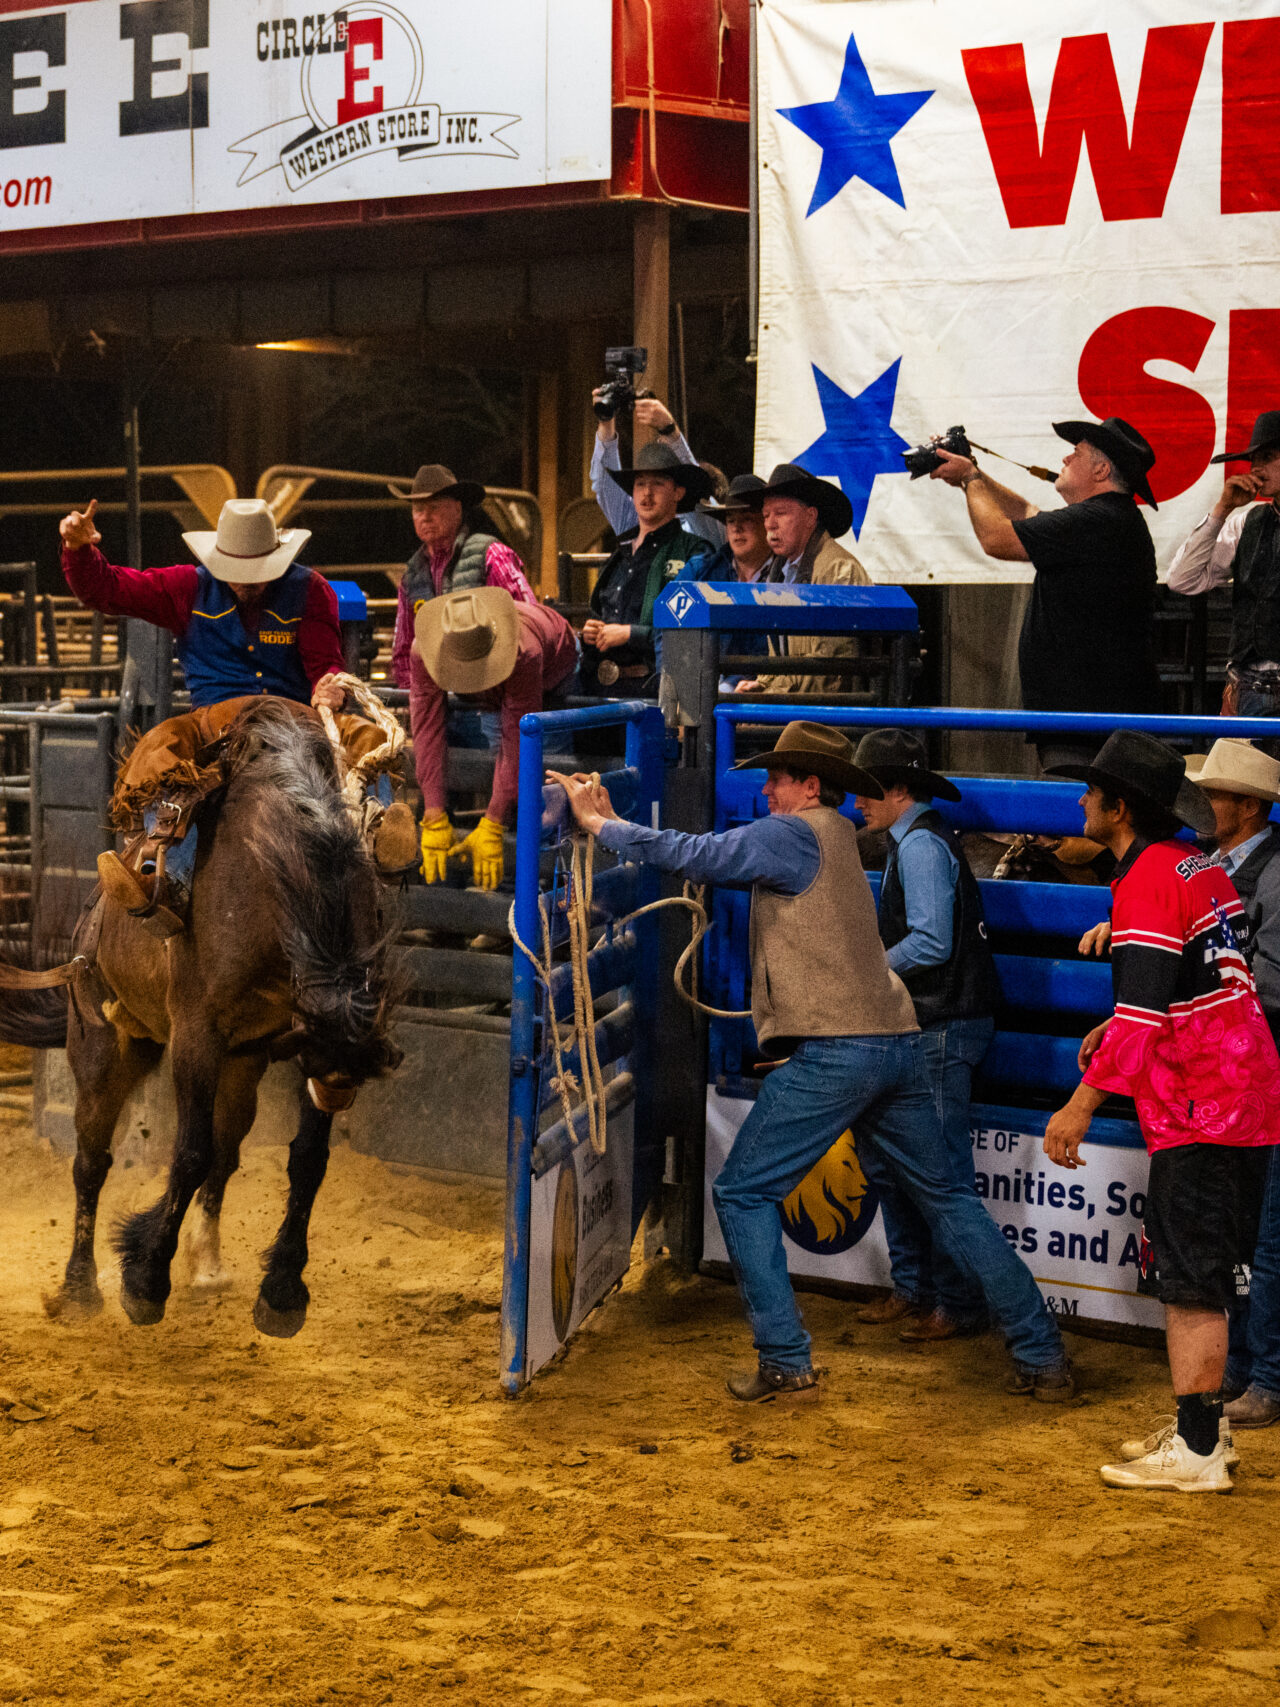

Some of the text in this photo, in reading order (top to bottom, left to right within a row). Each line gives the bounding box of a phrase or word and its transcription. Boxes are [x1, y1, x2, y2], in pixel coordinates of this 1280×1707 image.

[257, 11, 348, 61] CIRCLE
[119, 0, 210, 137] E
[289, 110, 482, 180] WESTERN STORE INC.
[994, 1131, 1020, 1153] OF
[997, 1222, 1038, 1253] es
[1047, 1229, 1109, 1264] and
